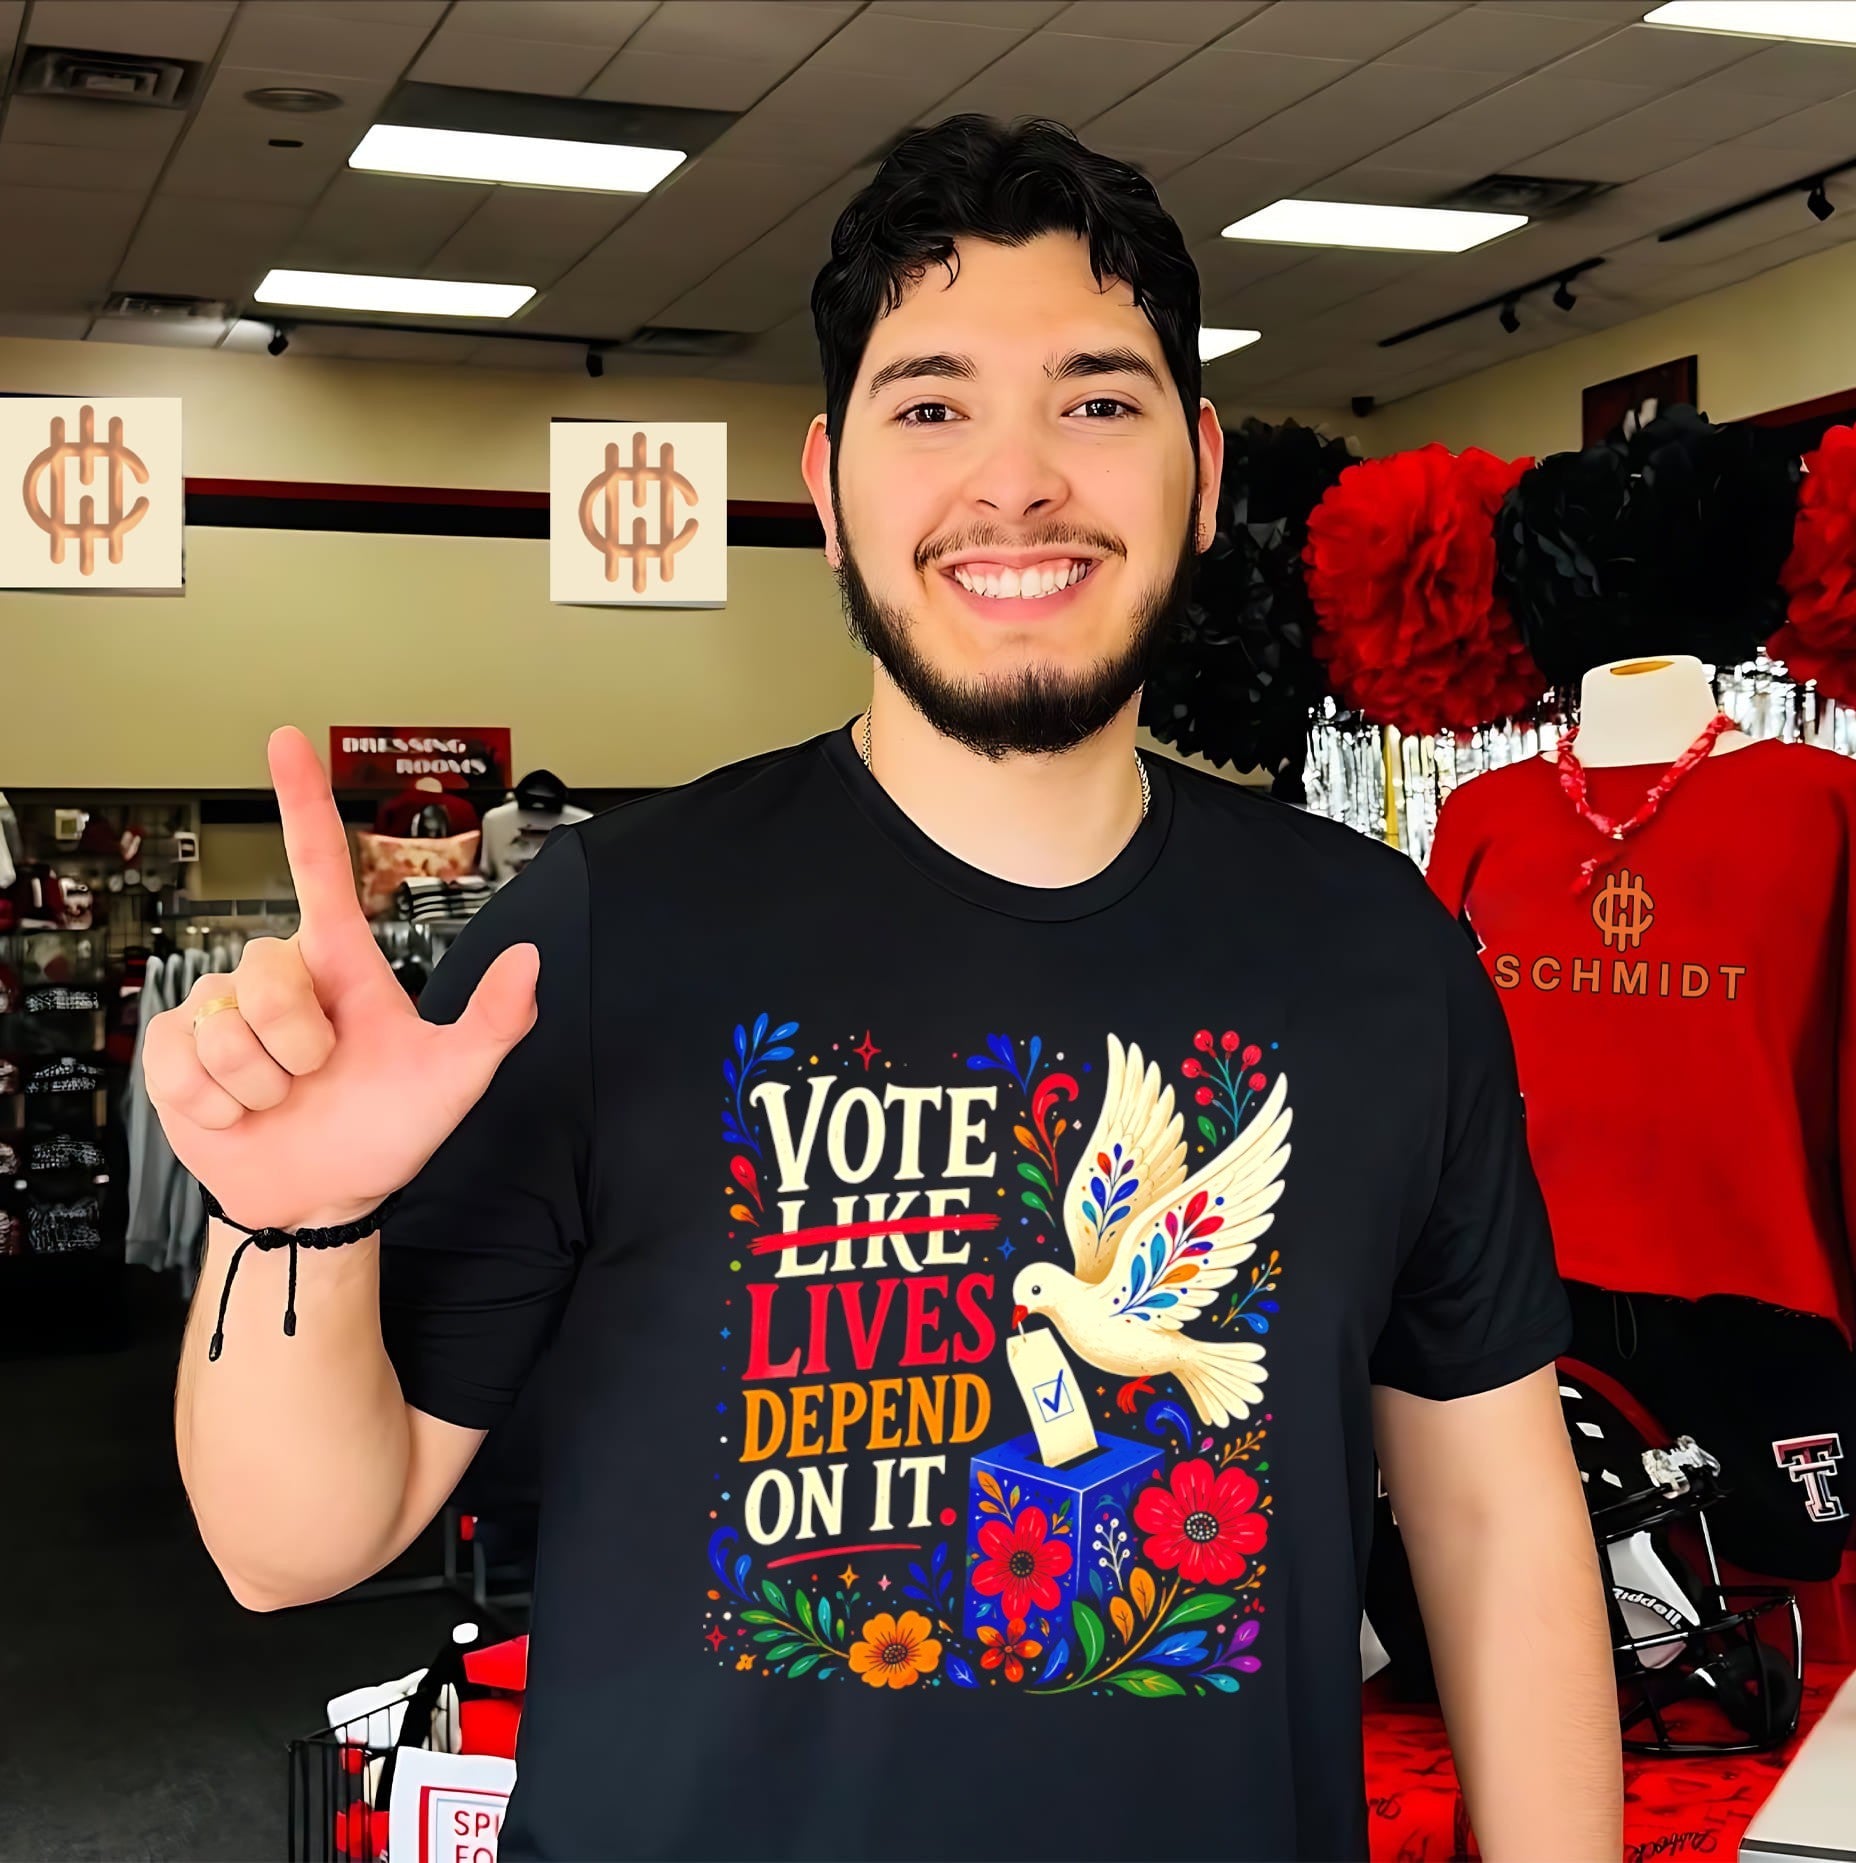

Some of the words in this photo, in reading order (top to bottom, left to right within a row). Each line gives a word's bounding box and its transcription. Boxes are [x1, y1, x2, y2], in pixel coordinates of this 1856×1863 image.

[341, 737, 467, 754] DRESSING
[396, 758, 487, 775] ROOMS
[1494, 954, 1747, 1000] SCHMIDT
[749, 1075, 998, 1193] VOTE
[774, 1187, 972, 1278] LIKE
[741, 1272, 996, 1381] LIVES
[738, 1373, 992, 1463] DEPEND
[744, 1462, 849, 1546] ON
[868, 1454, 957, 1532] IT.
